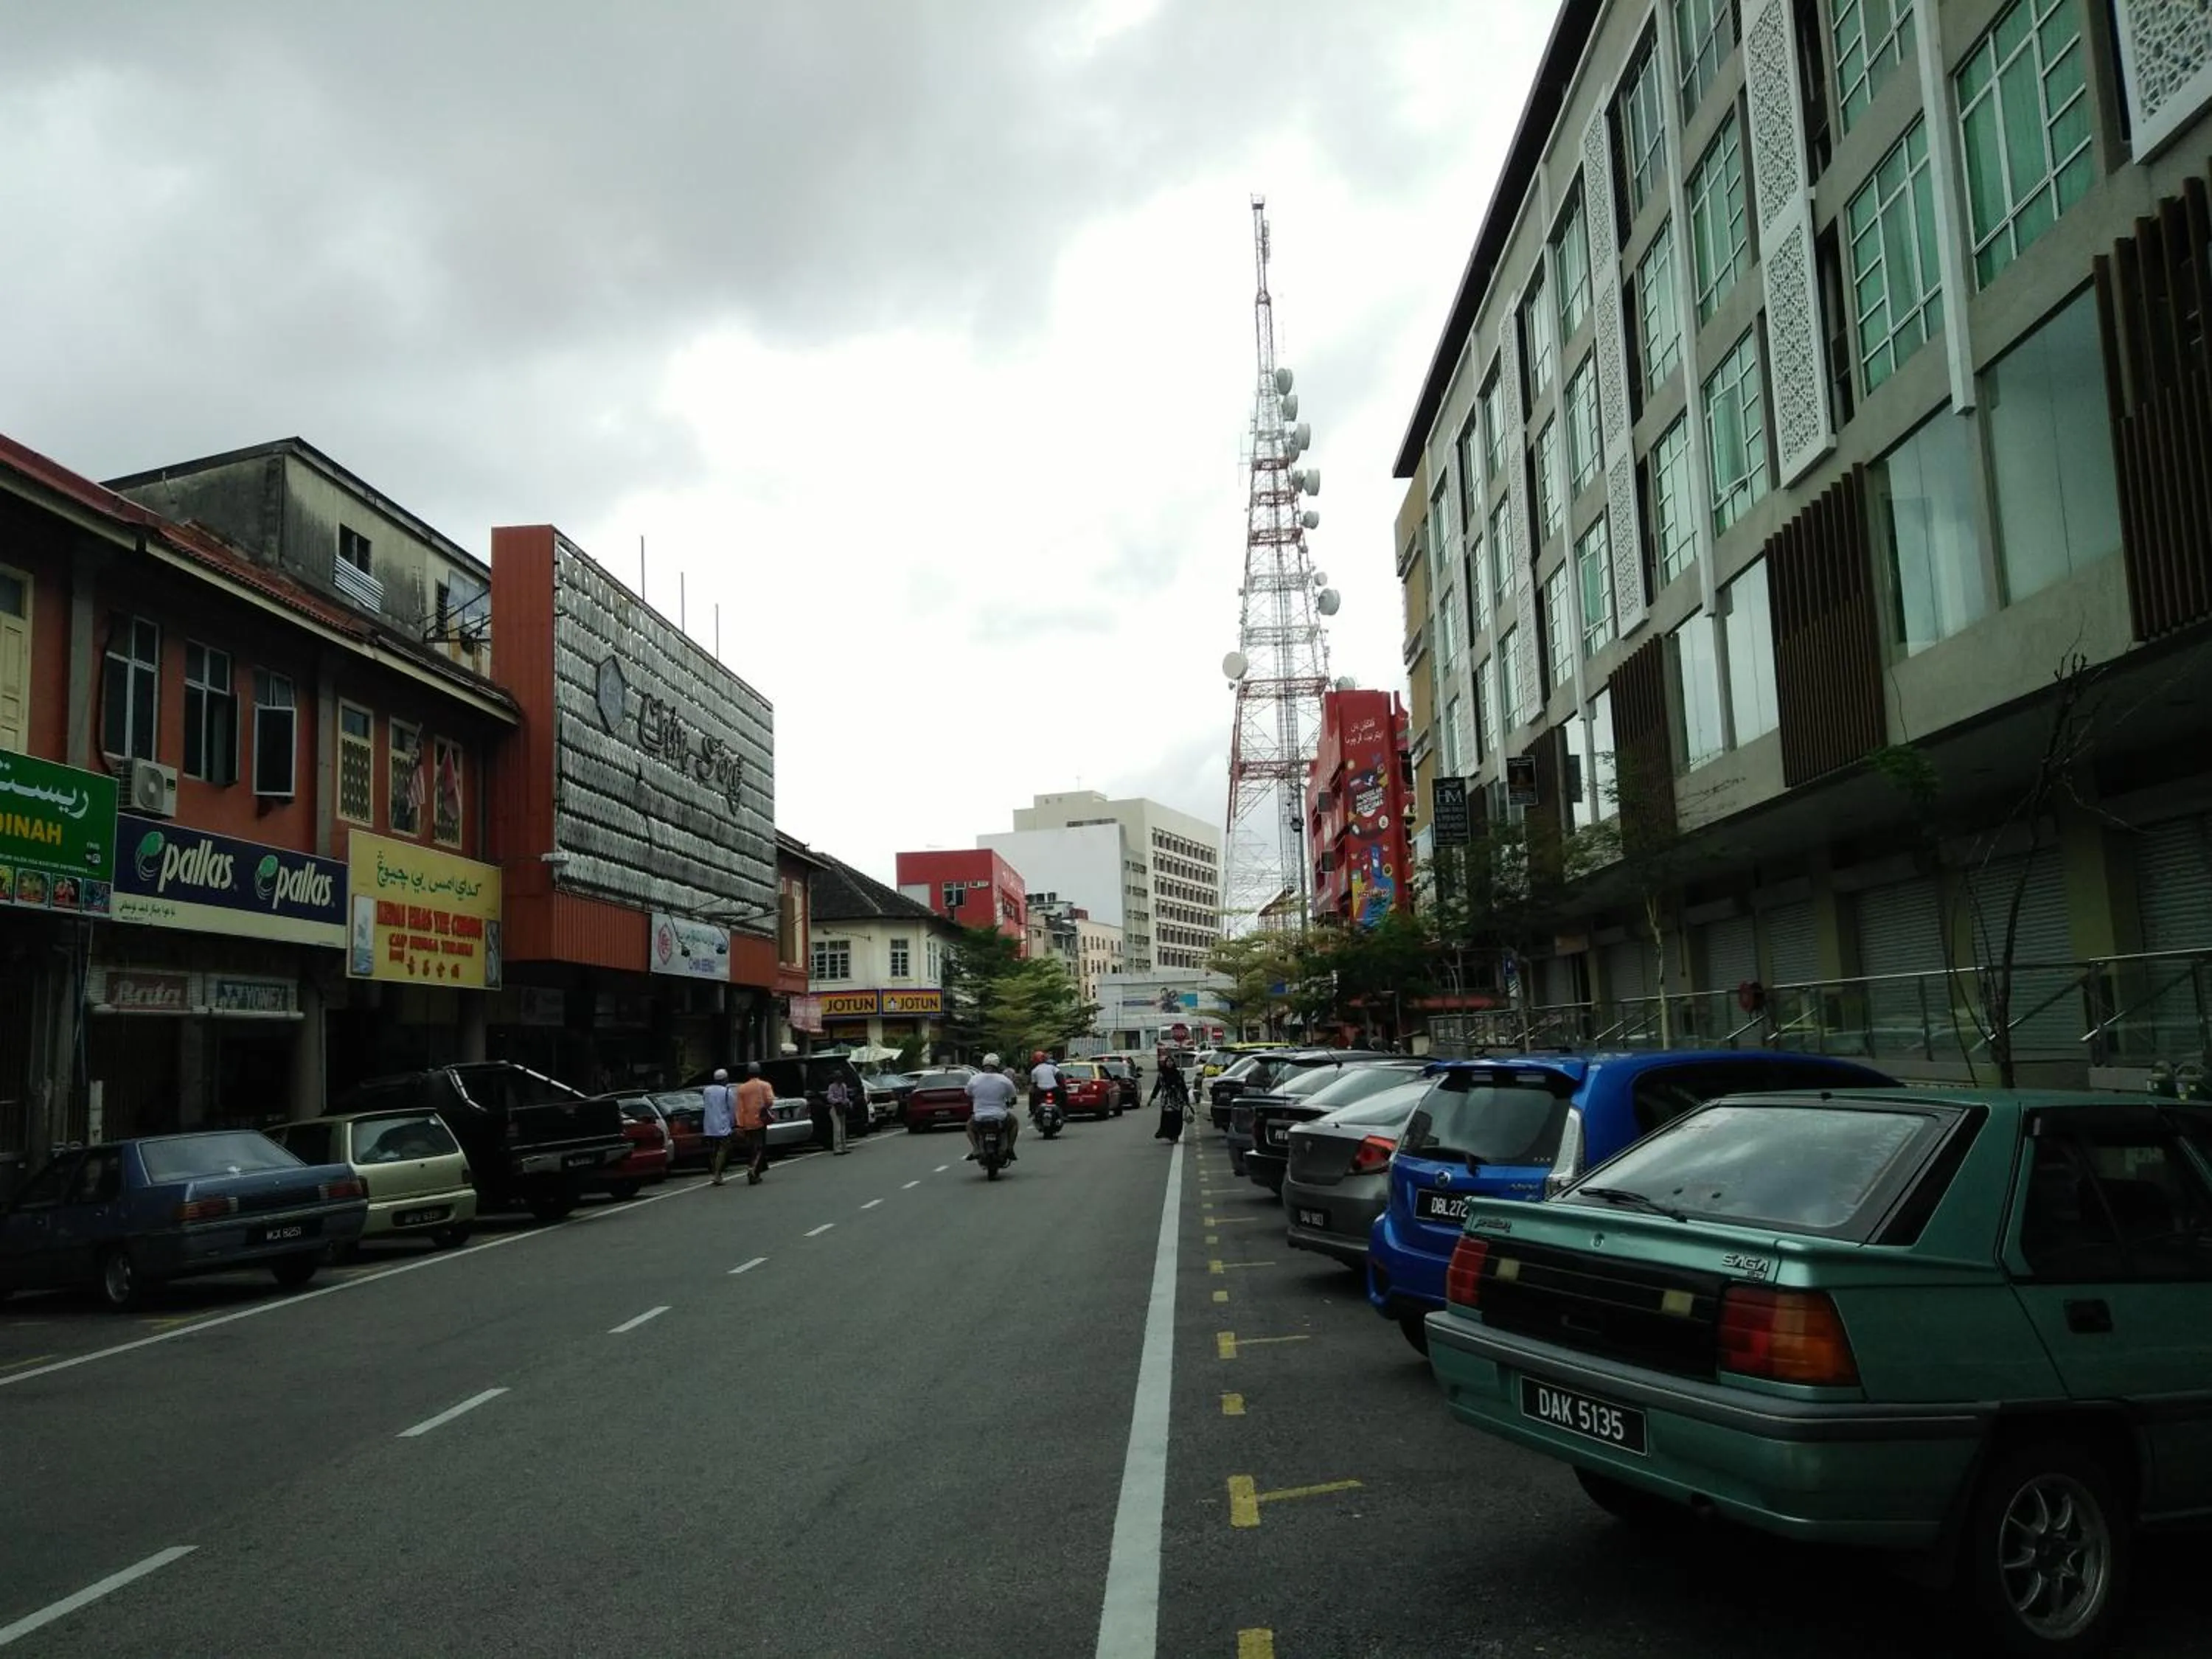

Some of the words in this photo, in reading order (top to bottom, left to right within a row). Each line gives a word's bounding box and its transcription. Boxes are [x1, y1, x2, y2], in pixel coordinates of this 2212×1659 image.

[158, 838, 234, 893] pallas
[272, 861, 333, 910] pallas
[826, 997, 874, 1012] JOTUN
[900, 996, 939, 1009] JOTUN
[1722, 1252, 1769, 1272] SAGA
[1538, 1388, 1573, 1426] DAK
[1579, 1408, 1625, 1441] 5135
